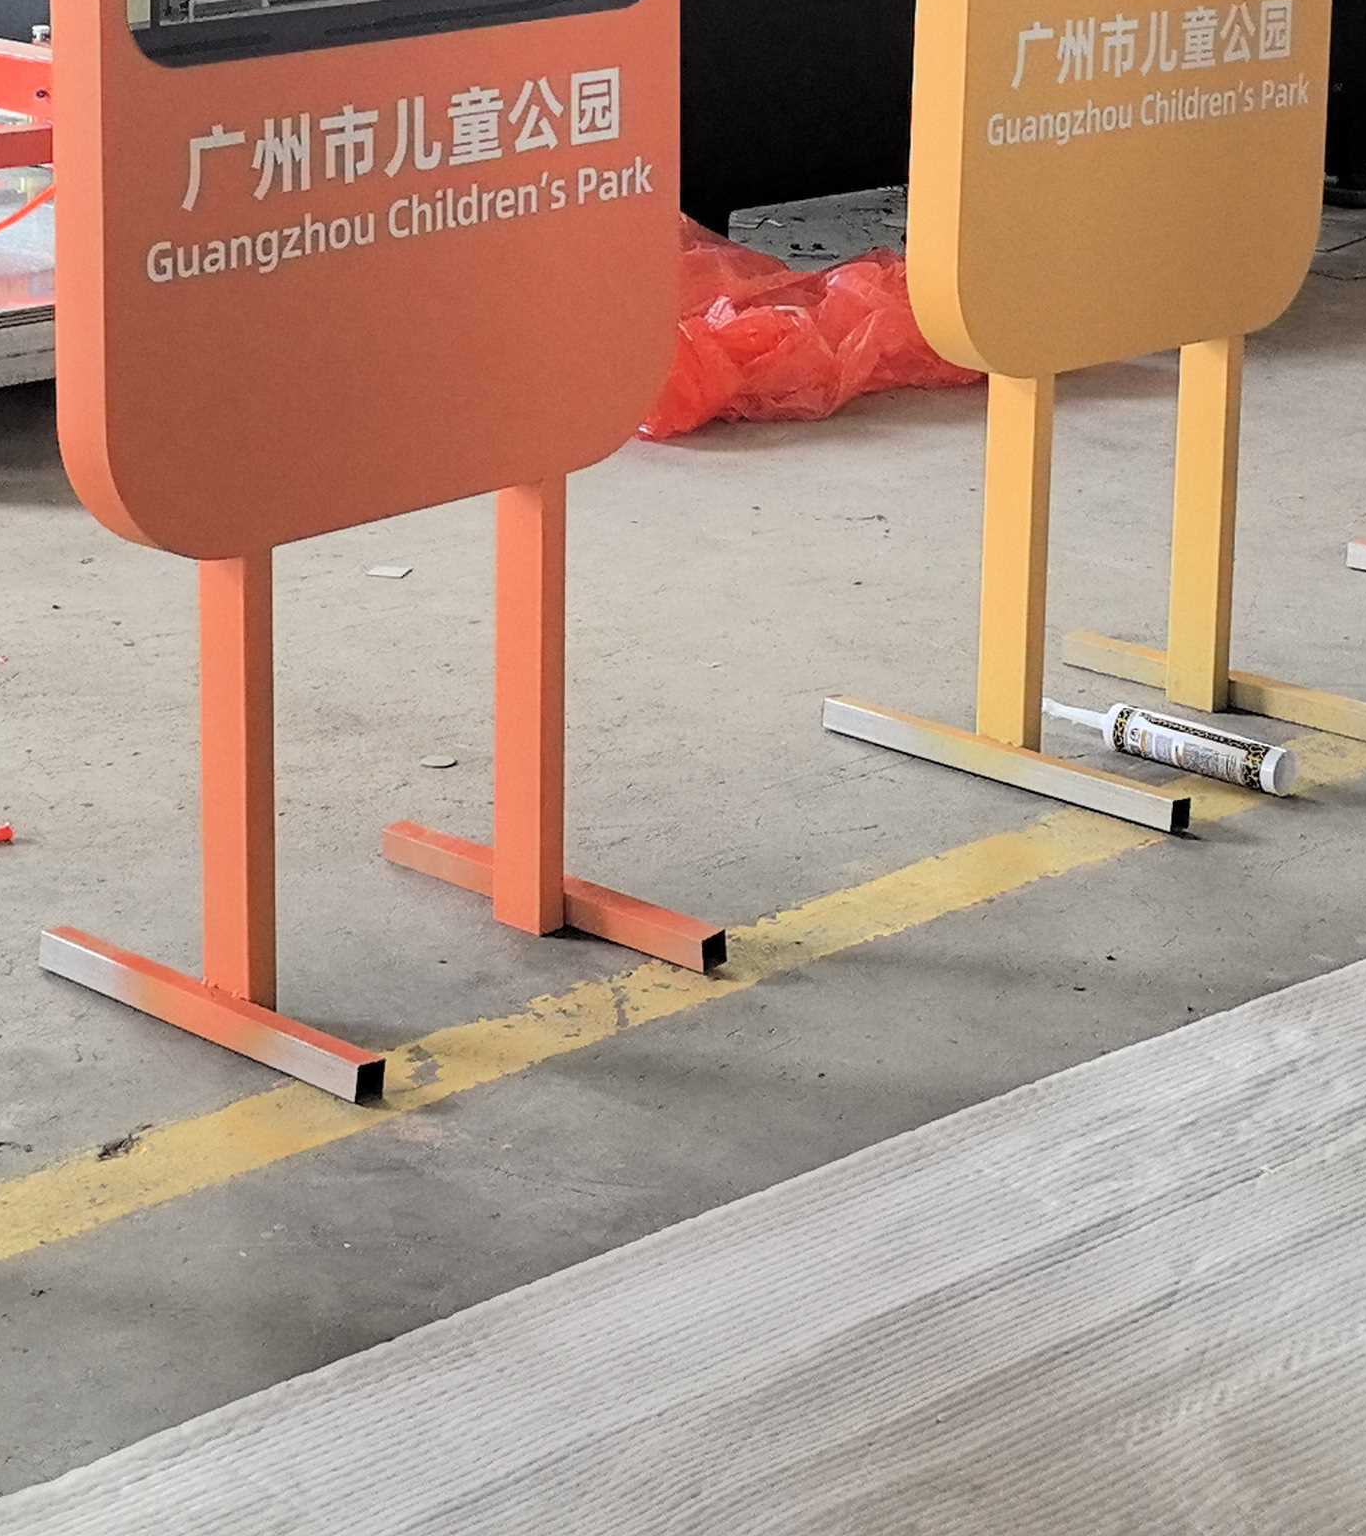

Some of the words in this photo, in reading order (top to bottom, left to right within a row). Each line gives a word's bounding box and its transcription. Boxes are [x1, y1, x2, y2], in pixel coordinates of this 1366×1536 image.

[181, 66, 620, 212] 广州市儿童公园
[987, 99, 1133, 146] Guangzhou
[1140, 81, 1253, 127] Children's
[1261, 73, 1309, 110] Park
[146, 211, 376, 283] Guangzhou
[387, 174, 566, 239] Children's
[577, 156, 653, 205] Park
